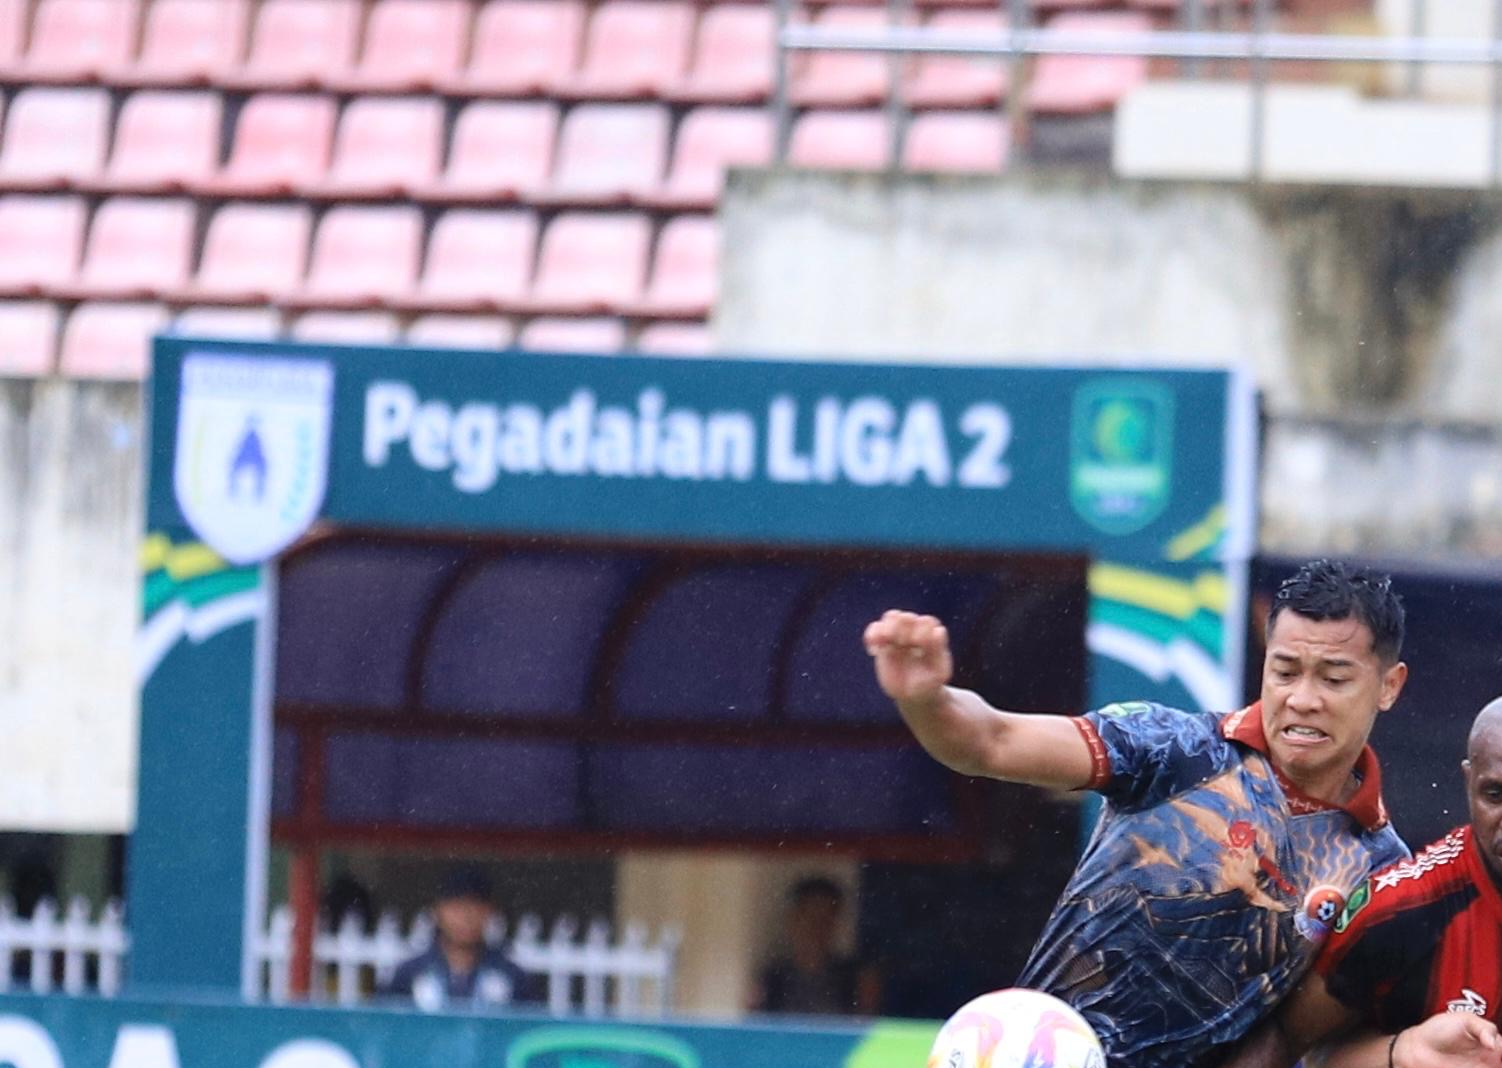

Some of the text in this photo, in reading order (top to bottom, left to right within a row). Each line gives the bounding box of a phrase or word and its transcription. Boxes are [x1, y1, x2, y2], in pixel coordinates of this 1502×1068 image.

[362, 381, 756, 493] Pegadaian
[767, 393, 953, 488] LIGA
[957, 400, 1012, 489] 2
